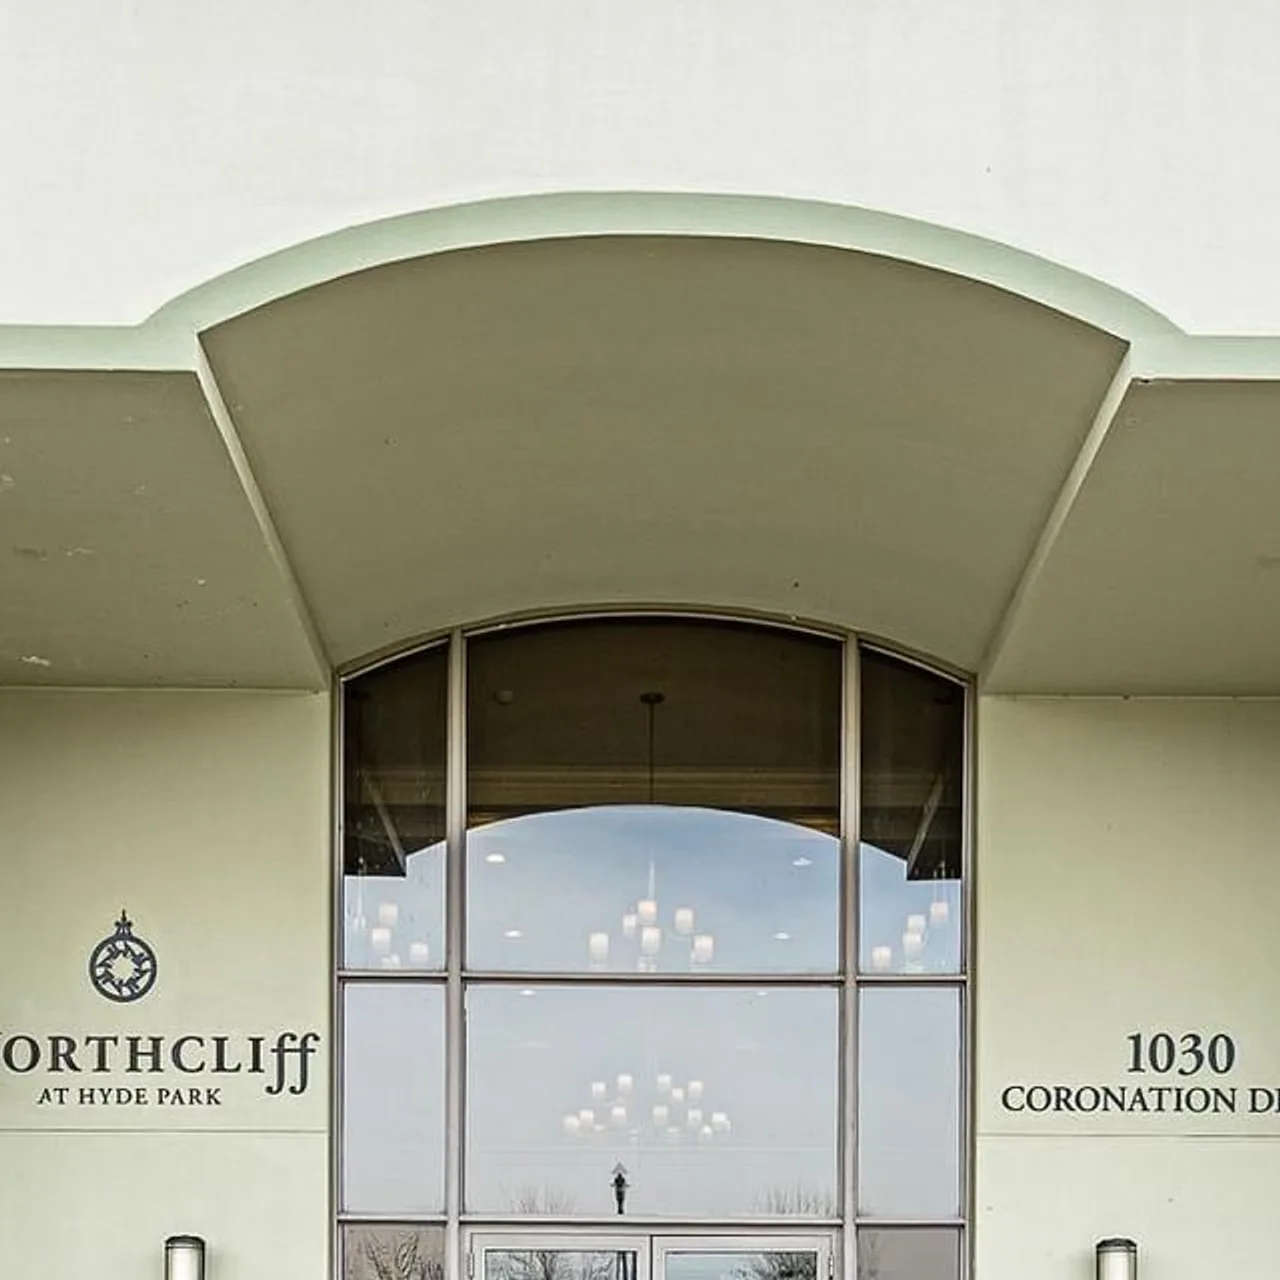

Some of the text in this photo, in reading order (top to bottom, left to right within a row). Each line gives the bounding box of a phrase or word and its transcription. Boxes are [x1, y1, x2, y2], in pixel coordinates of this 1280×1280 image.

[1127, 1032, 1236, 1076] 1030
[37, 1088, 221, 1105] AT HYDE PARK
[1001, 1085, 1237, 1113] CORONATION
